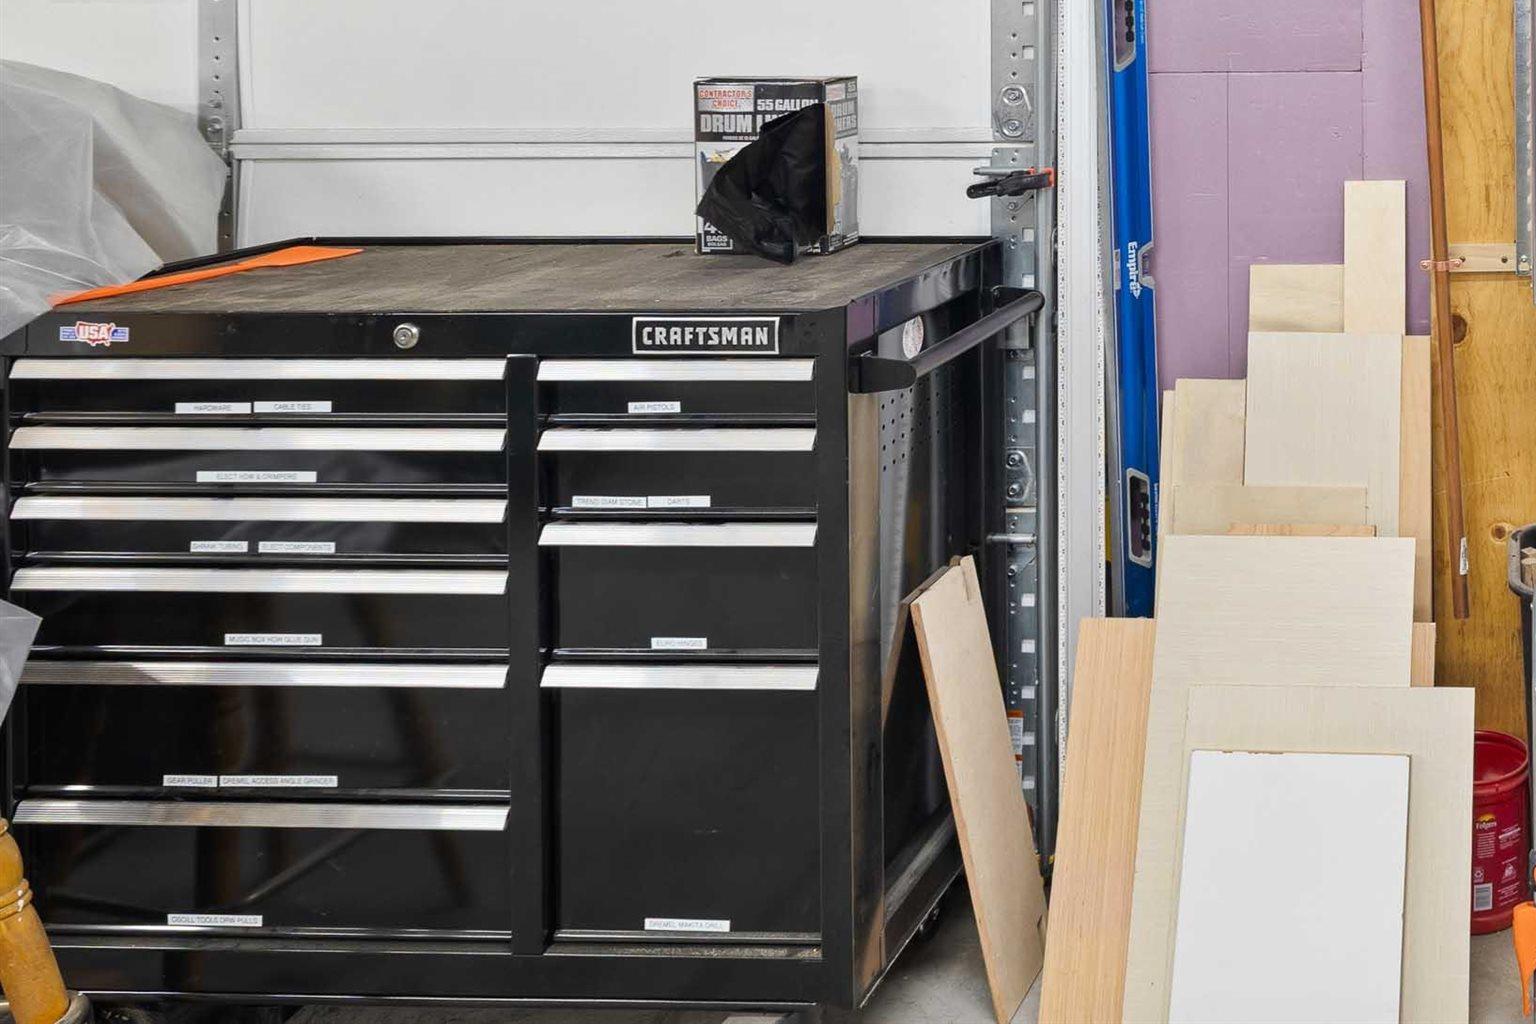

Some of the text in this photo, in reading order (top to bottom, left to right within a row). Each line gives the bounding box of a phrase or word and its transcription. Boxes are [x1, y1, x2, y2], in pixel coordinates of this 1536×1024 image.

[757, 98, 774, 111] 55
[700, 114, 753, 133] DRUM
[706, 235, 728, 243] BAGS
[79, 324, 109, 340] USA
[642, 326, 769, 345] CRAFTSMAN
